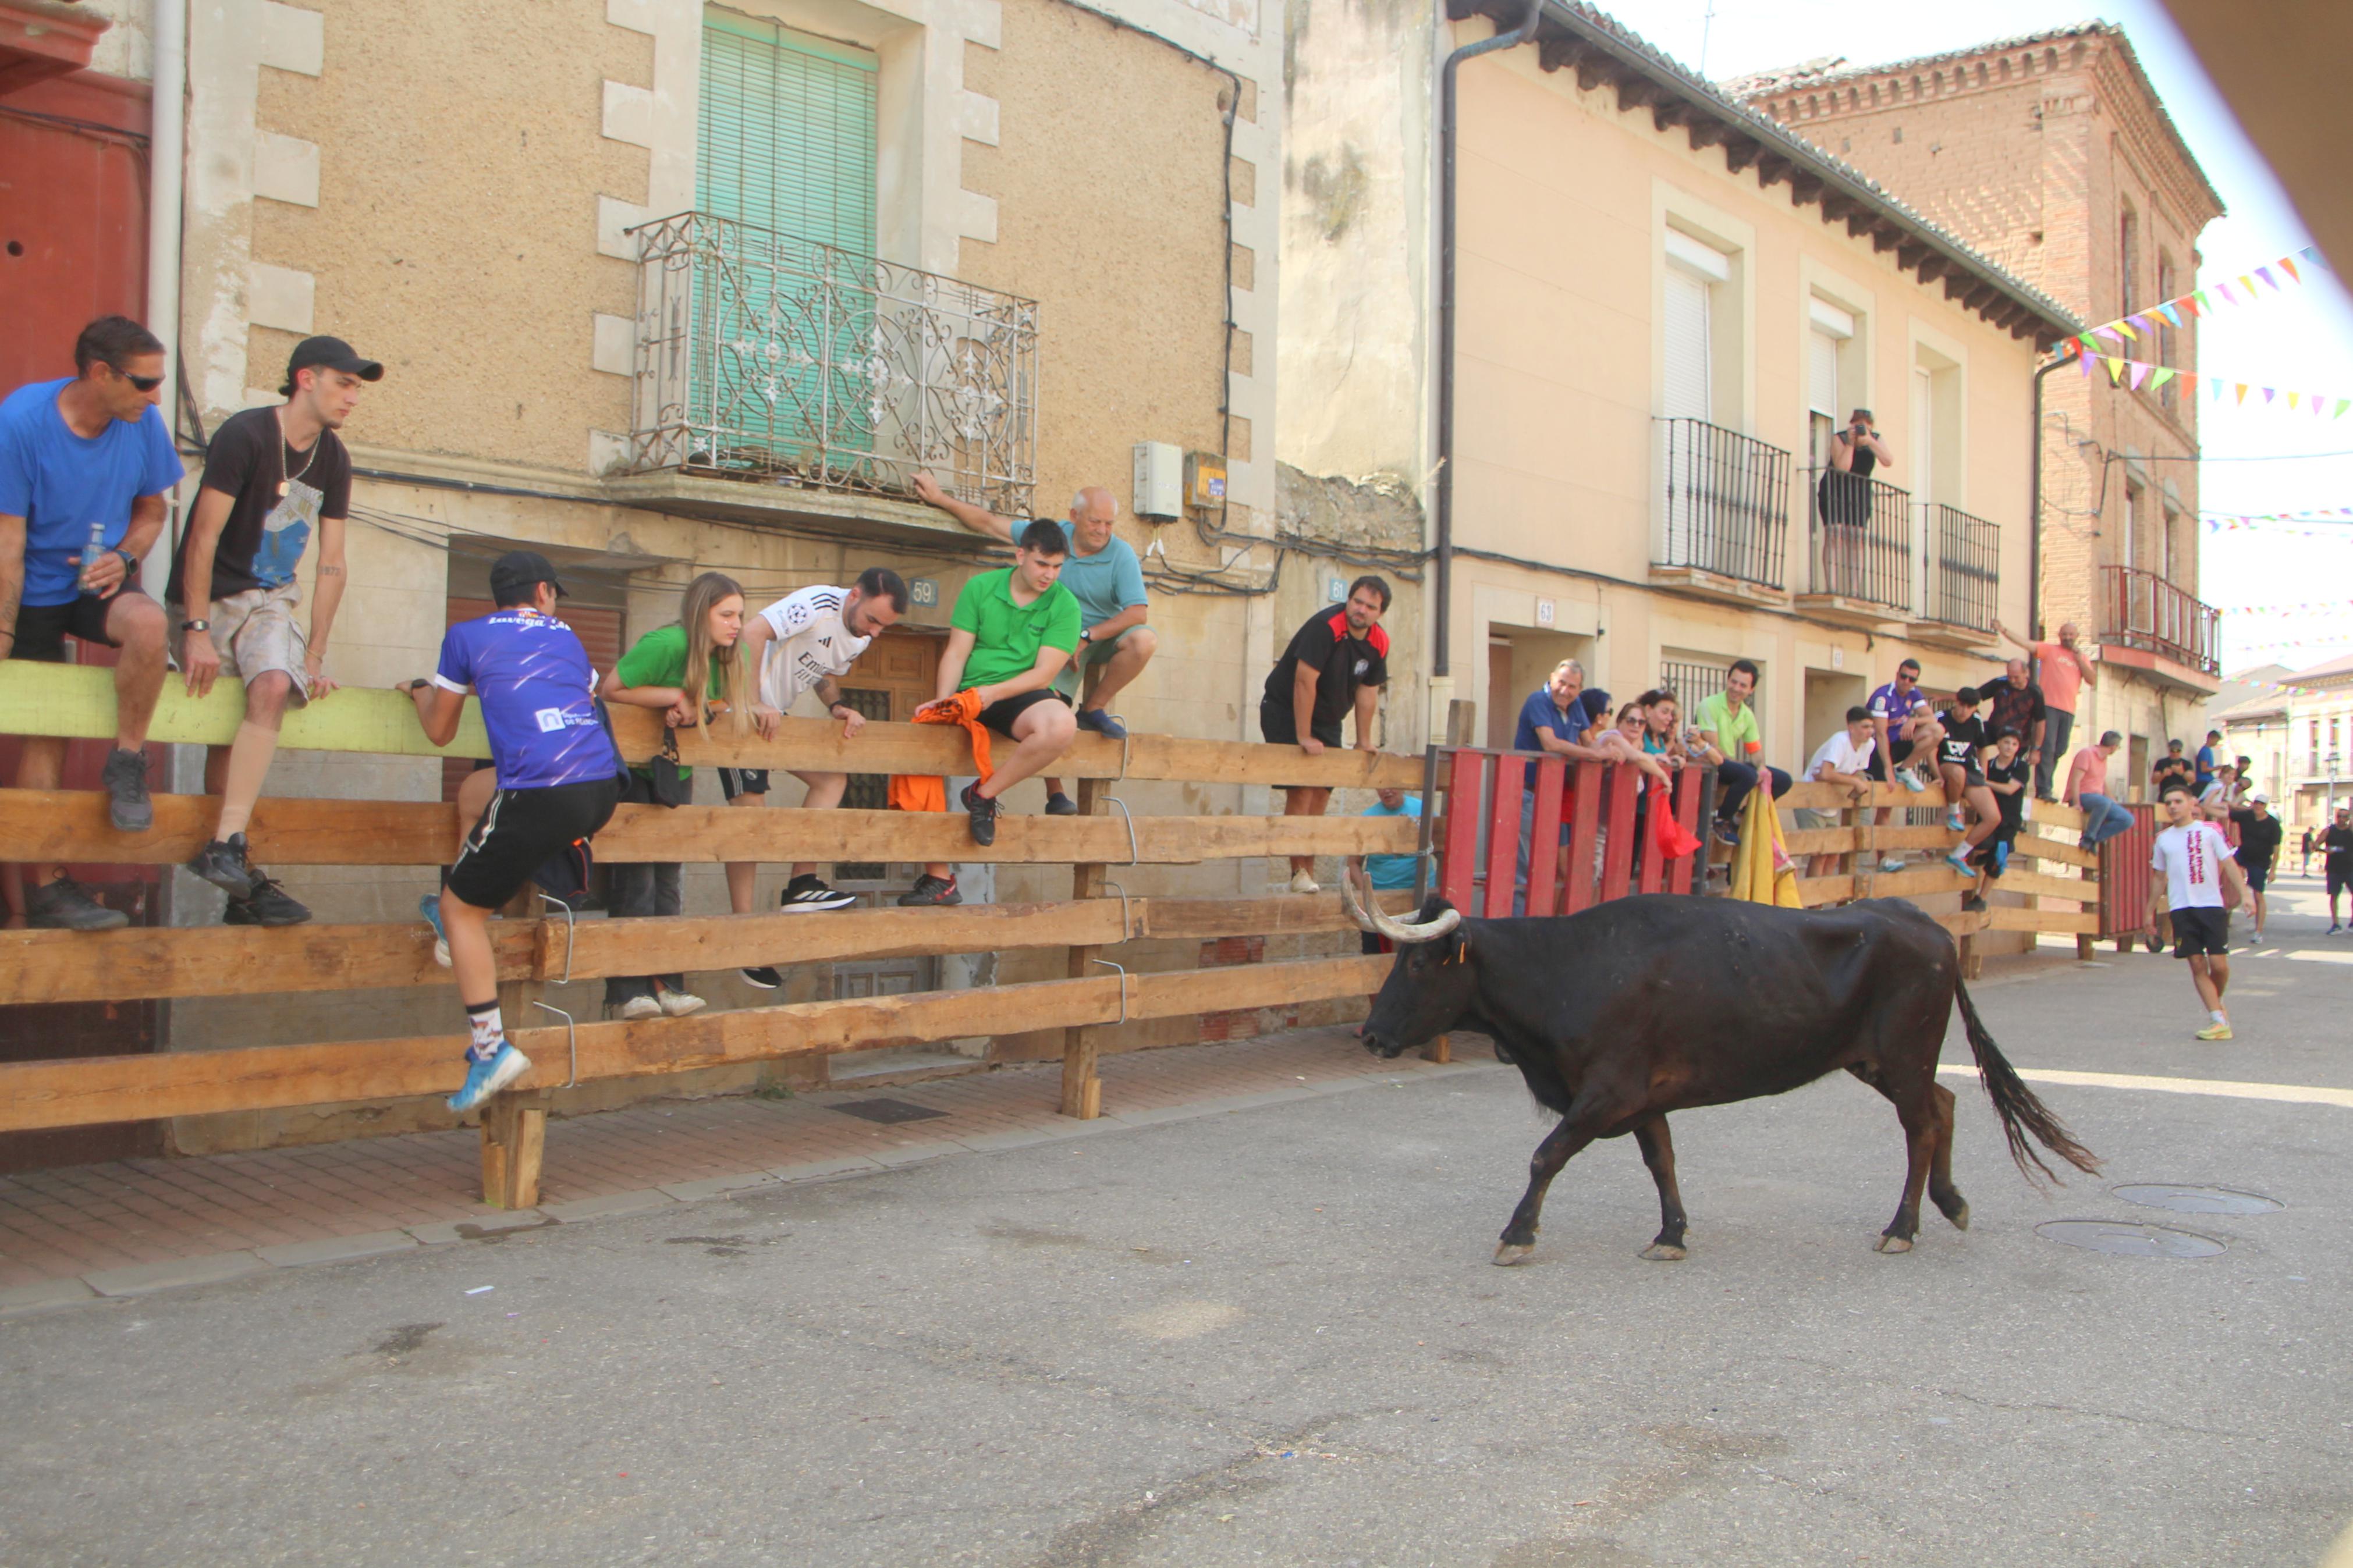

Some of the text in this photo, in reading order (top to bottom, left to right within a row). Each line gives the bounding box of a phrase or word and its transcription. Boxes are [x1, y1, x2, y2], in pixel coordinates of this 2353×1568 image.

[913, 581, 931, 603] 59
[1333, 581, 1343, 599] 61
[1540, 604, 1552, 622] 63
